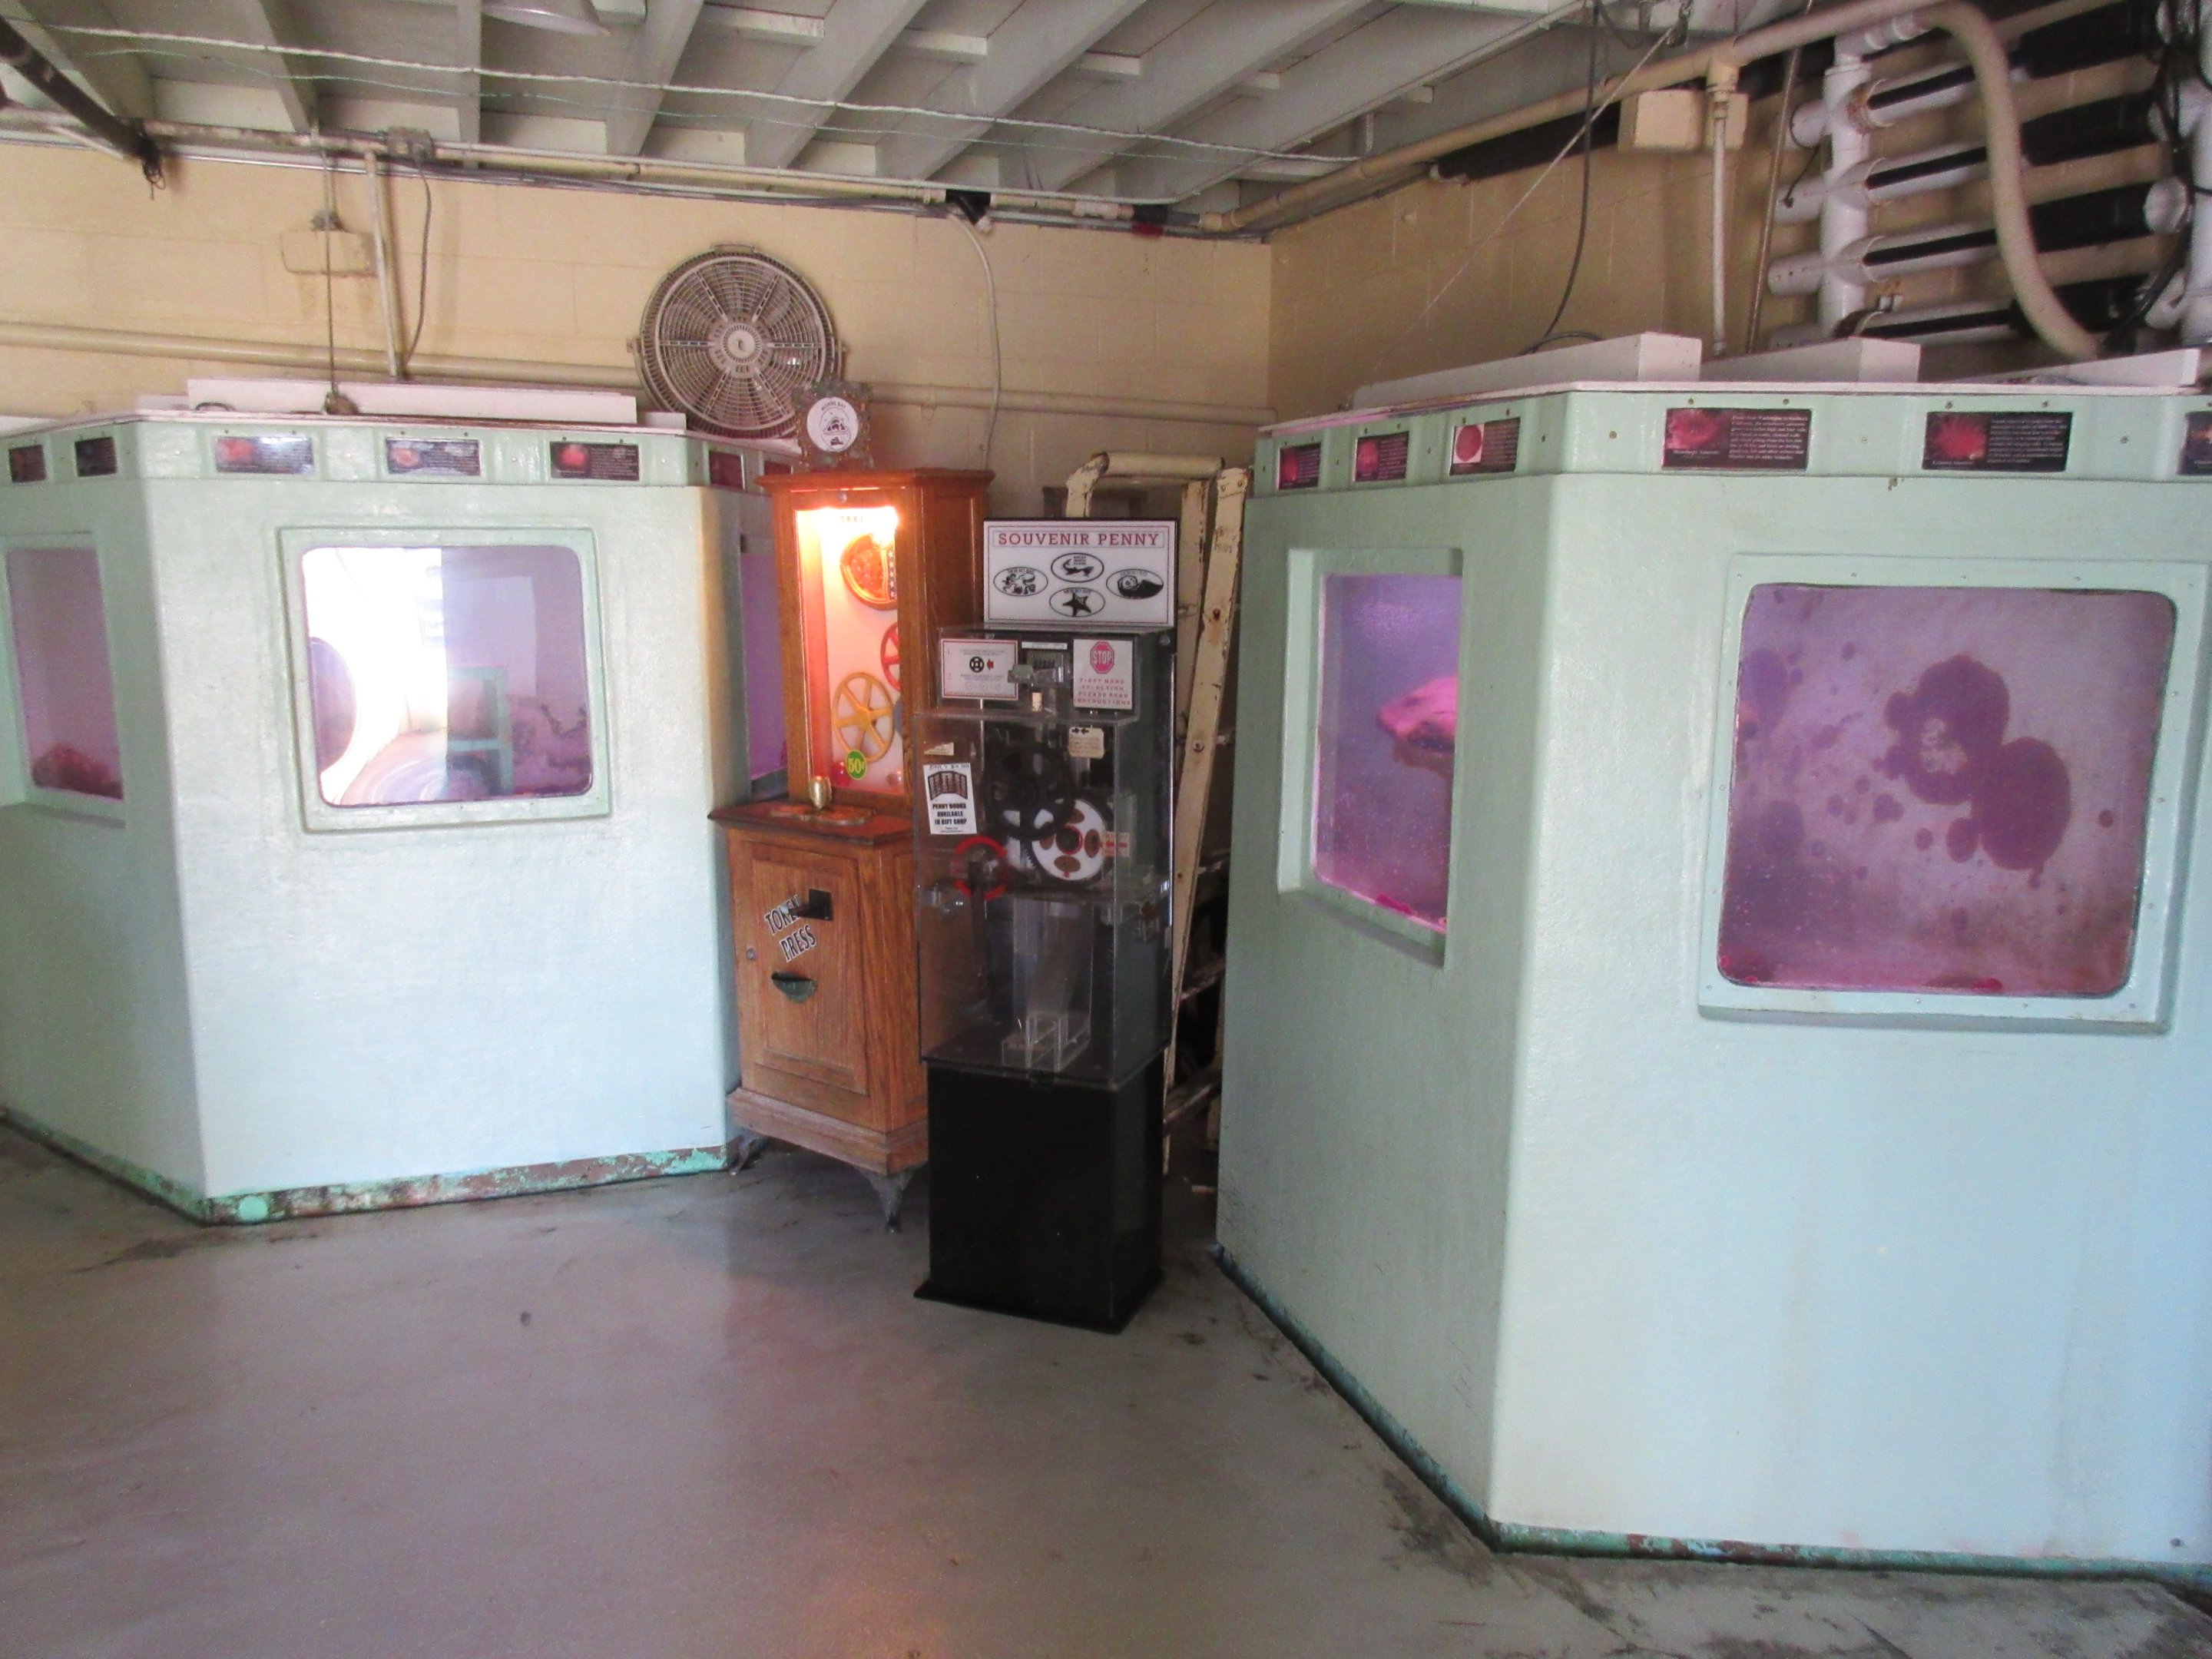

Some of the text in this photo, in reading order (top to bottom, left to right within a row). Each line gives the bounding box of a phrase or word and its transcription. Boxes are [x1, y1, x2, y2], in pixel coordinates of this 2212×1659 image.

[998, 533, 1160, 545] SOUVENIR PENNY
[1092, 650, 1112, 664] STOP
[780, 925, 816, 961] PRESS
